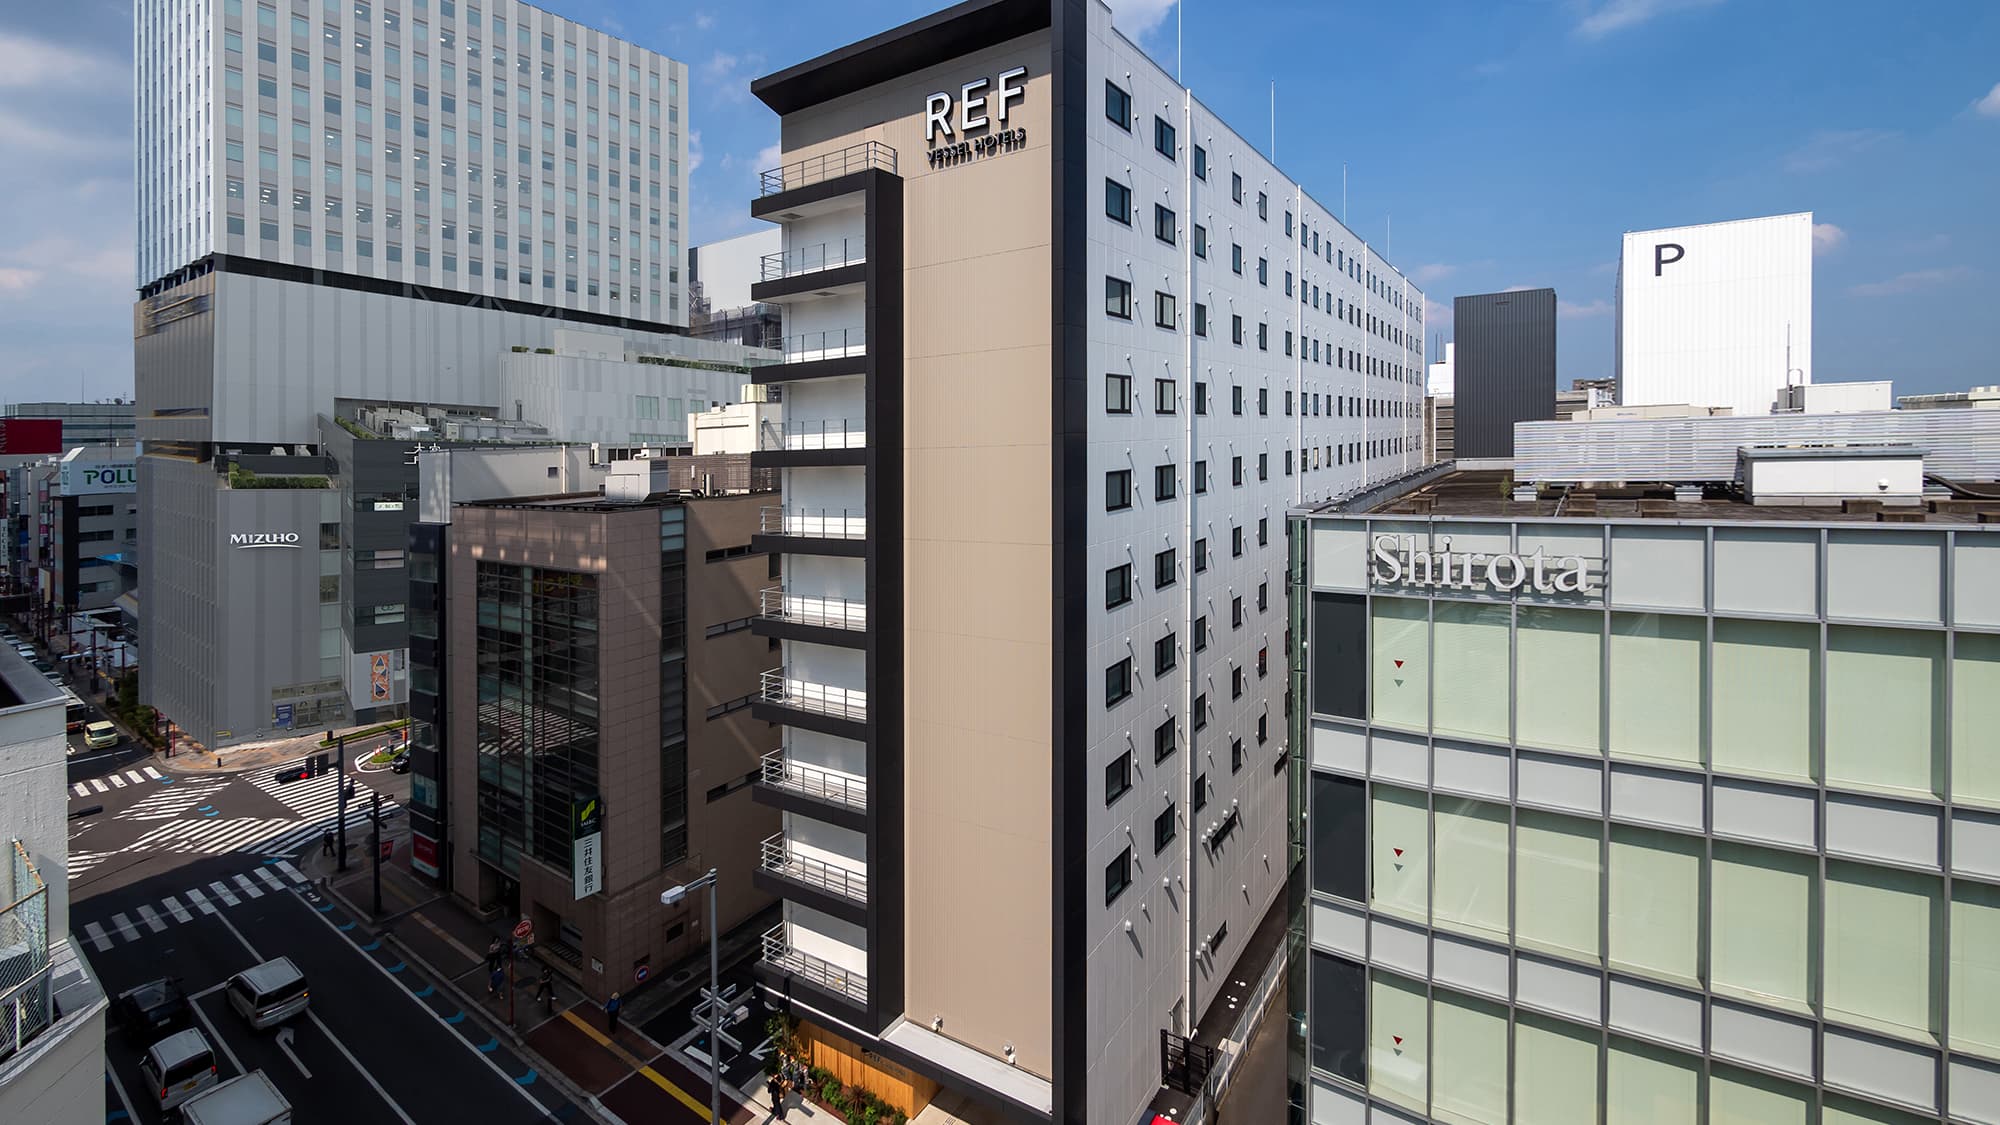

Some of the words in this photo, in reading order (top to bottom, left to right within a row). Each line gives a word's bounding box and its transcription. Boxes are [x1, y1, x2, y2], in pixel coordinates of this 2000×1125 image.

[926, 66, 1026, 141] REF
[926, 141, 971, 162] VESSEL
[974, 127, 1026, 150] HOTELS
[1655, 243, 1685, 277] P
[230, 532, 299, 544] MIZUHO
[1373, 534, 1594, 593] Shirota
[584, 837, 593, 893] 三井住友銀行
